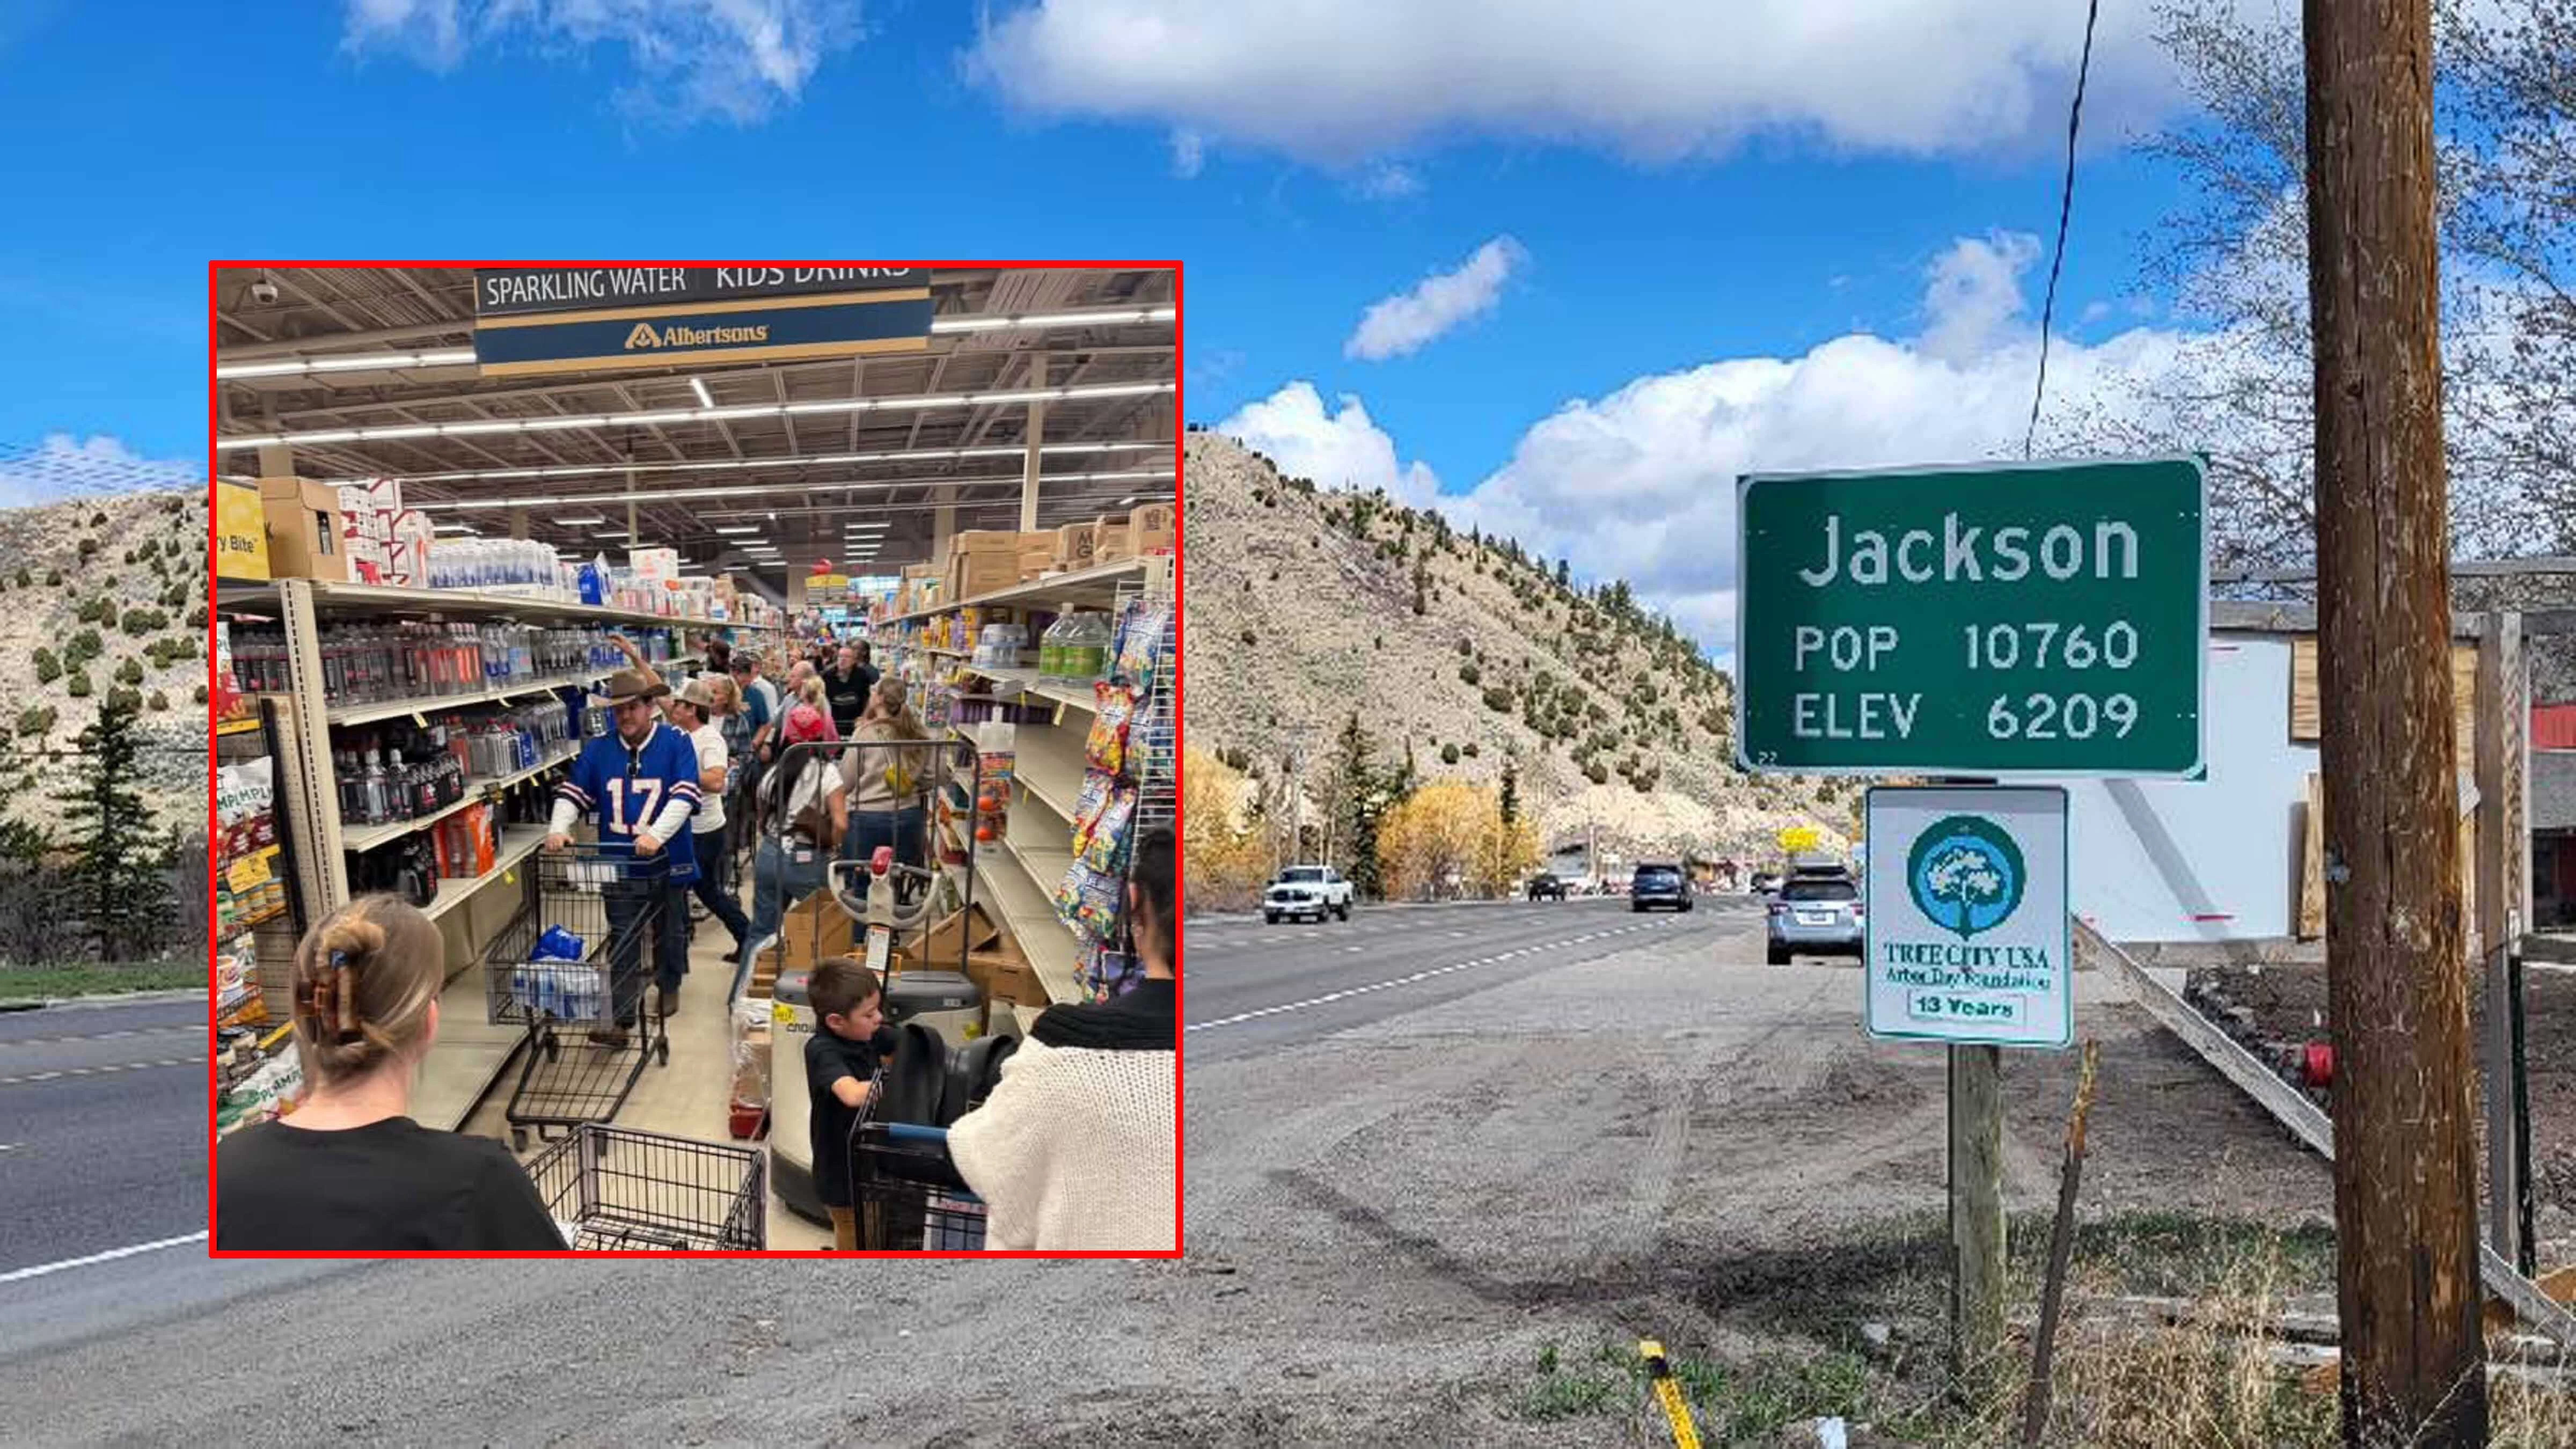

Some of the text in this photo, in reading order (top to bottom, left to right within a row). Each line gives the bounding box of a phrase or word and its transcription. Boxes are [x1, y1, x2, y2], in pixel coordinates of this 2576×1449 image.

[487, 269, 605, 305] SPARKLING
[609, 268, 686, 296] WATER
[663, 325, 769, 346] Albertsons
[1799, 513, 2138, 587] Jackson
[1795, 621, 2138, 672] POP 10760
[1794, 693, 2138, 740] ELEV 6209
[606, 778, 662, 835] 17
[1884, 944, 1943, 964] TREE
[1917, 997, 2014, 1018] 13 Years
